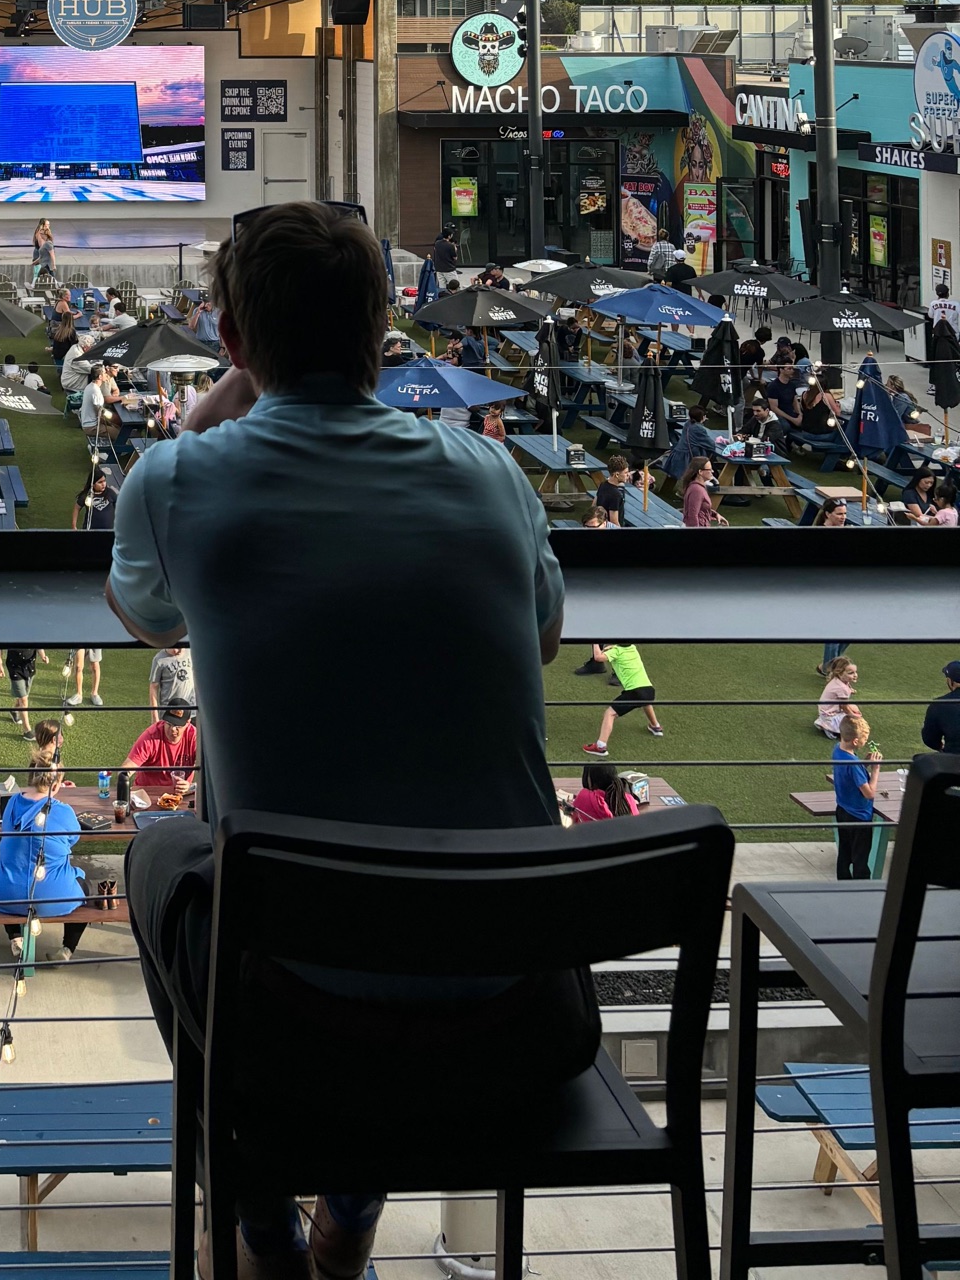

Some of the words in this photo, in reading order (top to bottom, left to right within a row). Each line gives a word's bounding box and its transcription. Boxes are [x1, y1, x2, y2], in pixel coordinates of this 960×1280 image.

[225, 88, 239, 96] SKIP
[240, 88, 250, 96] THE
[222, 97, 239, 106] DRINK
[241, 97, 253, 106] LINE
[451, 85, 561, 114] MACHO
[569, 85, 648, 114] TACO
[925, 91, 955, 106] SUPER
[224, 106, 231, 115] AT
[232, 106, 251, 115] SPOKE
[735, 93, 804, 132] CANTINA
[923, 106, 958, 120] FREEZE
[224, 131, 251, 139] UPCOMING
[228, 140, 247, 148] EVENTS
[146, 154, 167, 164] OMG!
[875, 146, 925, 169] SHAKES
[623, 182, 637, 191] FAT
[638, 182, 655, 192] BOY
[658, 307, 692, 316] ULTRA
[397, 387, 440, 395] ULTRA
[0, 400, 37, 410] WATER
